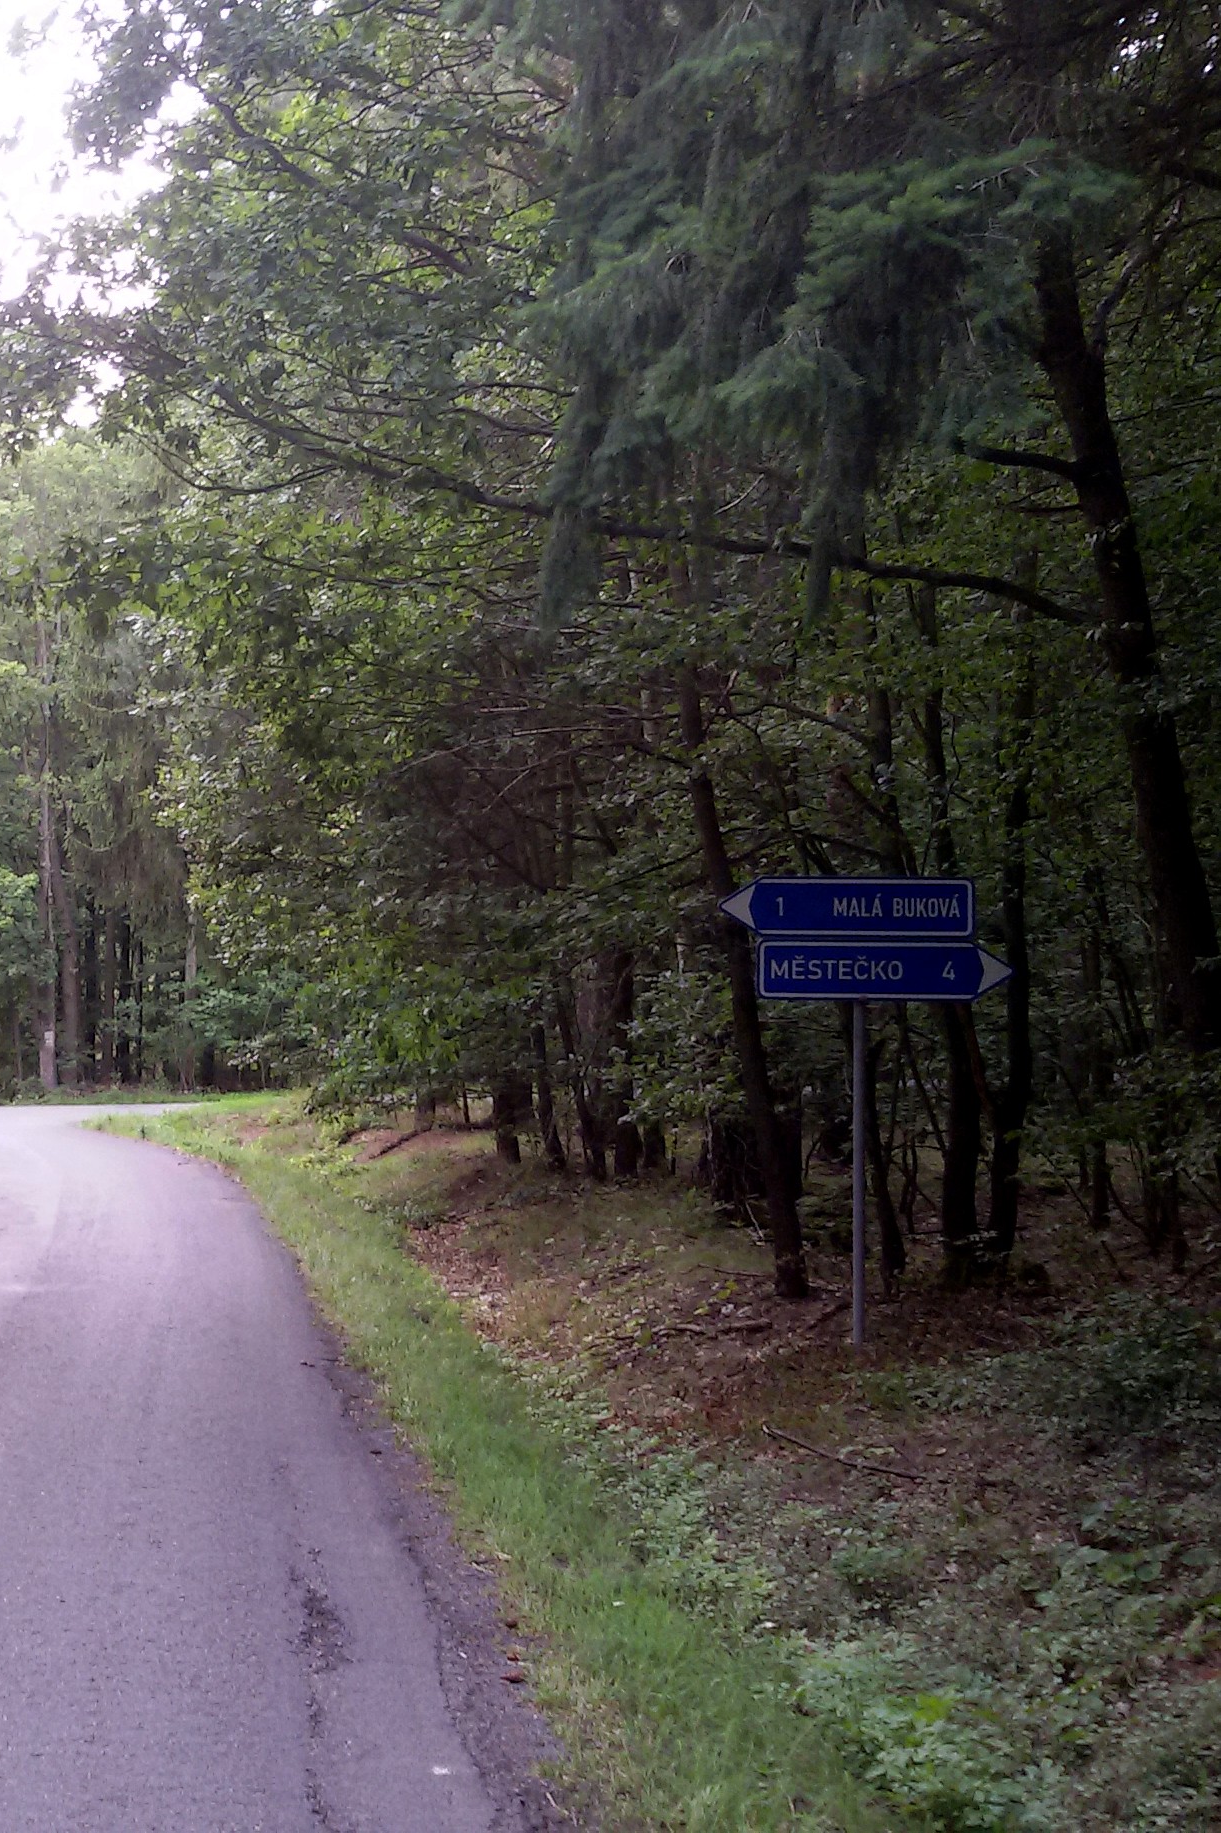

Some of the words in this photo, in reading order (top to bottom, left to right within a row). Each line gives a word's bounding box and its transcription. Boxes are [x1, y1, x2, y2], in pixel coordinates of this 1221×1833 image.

[775, 896, 784, 917] 1
[833, 893, 883, 918] MALÁ
[892, 893, 961, 918] BUKOVÁ
[770, 955, 904, 981] MĚSTEČKO
[942, 960, 956, 981] 4
